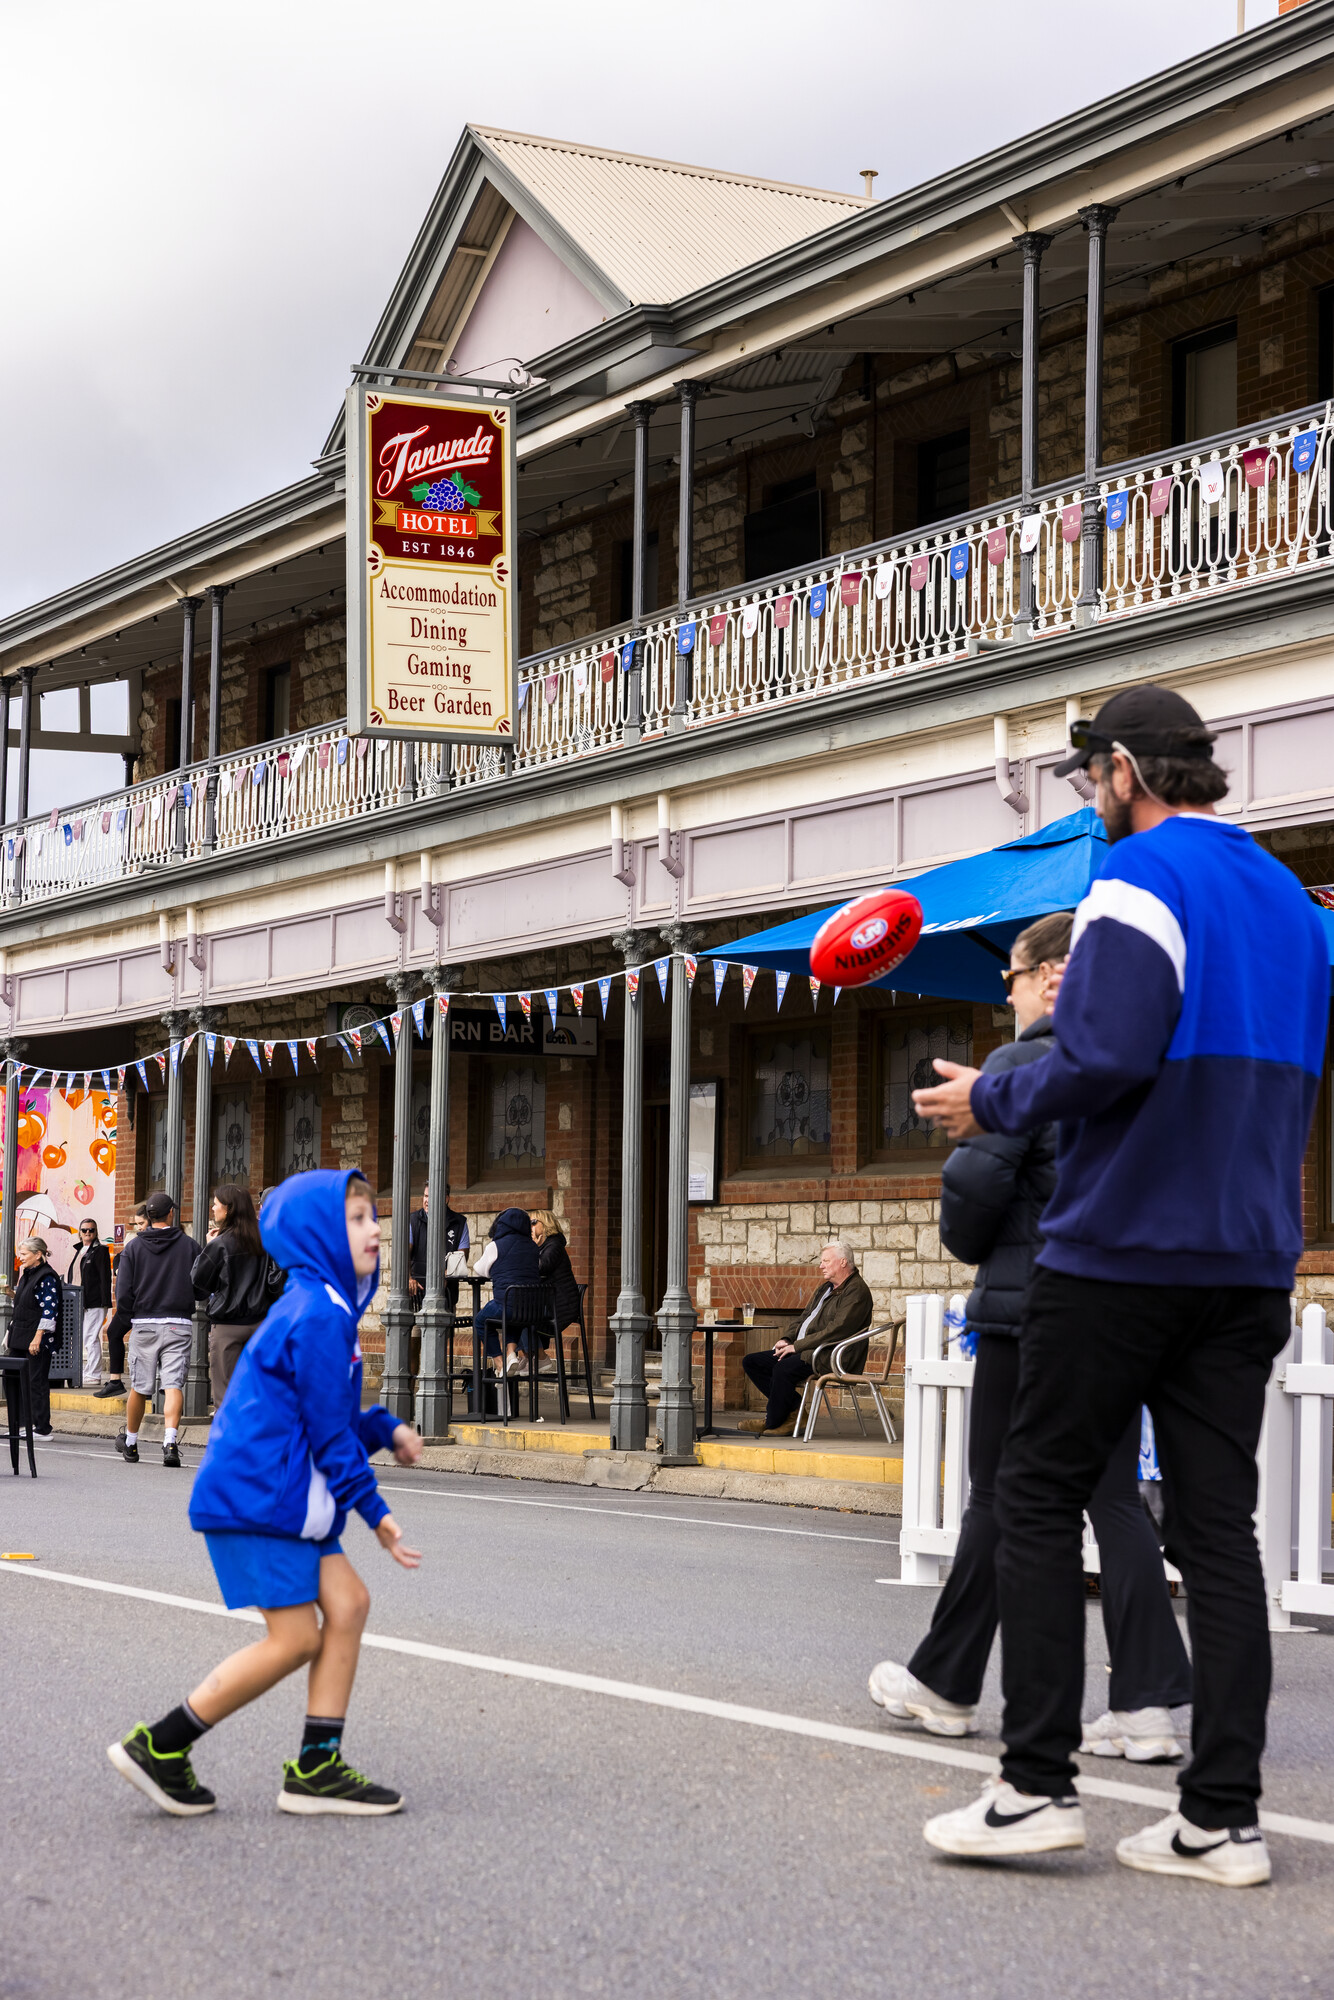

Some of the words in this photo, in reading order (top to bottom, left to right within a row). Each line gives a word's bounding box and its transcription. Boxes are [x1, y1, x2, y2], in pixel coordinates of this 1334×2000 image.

[376, 424, 495, 498] Tanunda
[401, 512, 474, 536] HOTEL
[402, 541, 431, 554] EST
[439, 544, 476, 559] 1846
[379, 577, 498, 608] Accommodation
[410, 617, 468, 648] Dining
[407, 653, 472, 684] Gaming
[387, 688, 426, 713] Beer
[433, 692, 493, 717] Garden
[835, 912, 912, 970] SHERRIN
[489, 1022, 535, 1045] BAR
